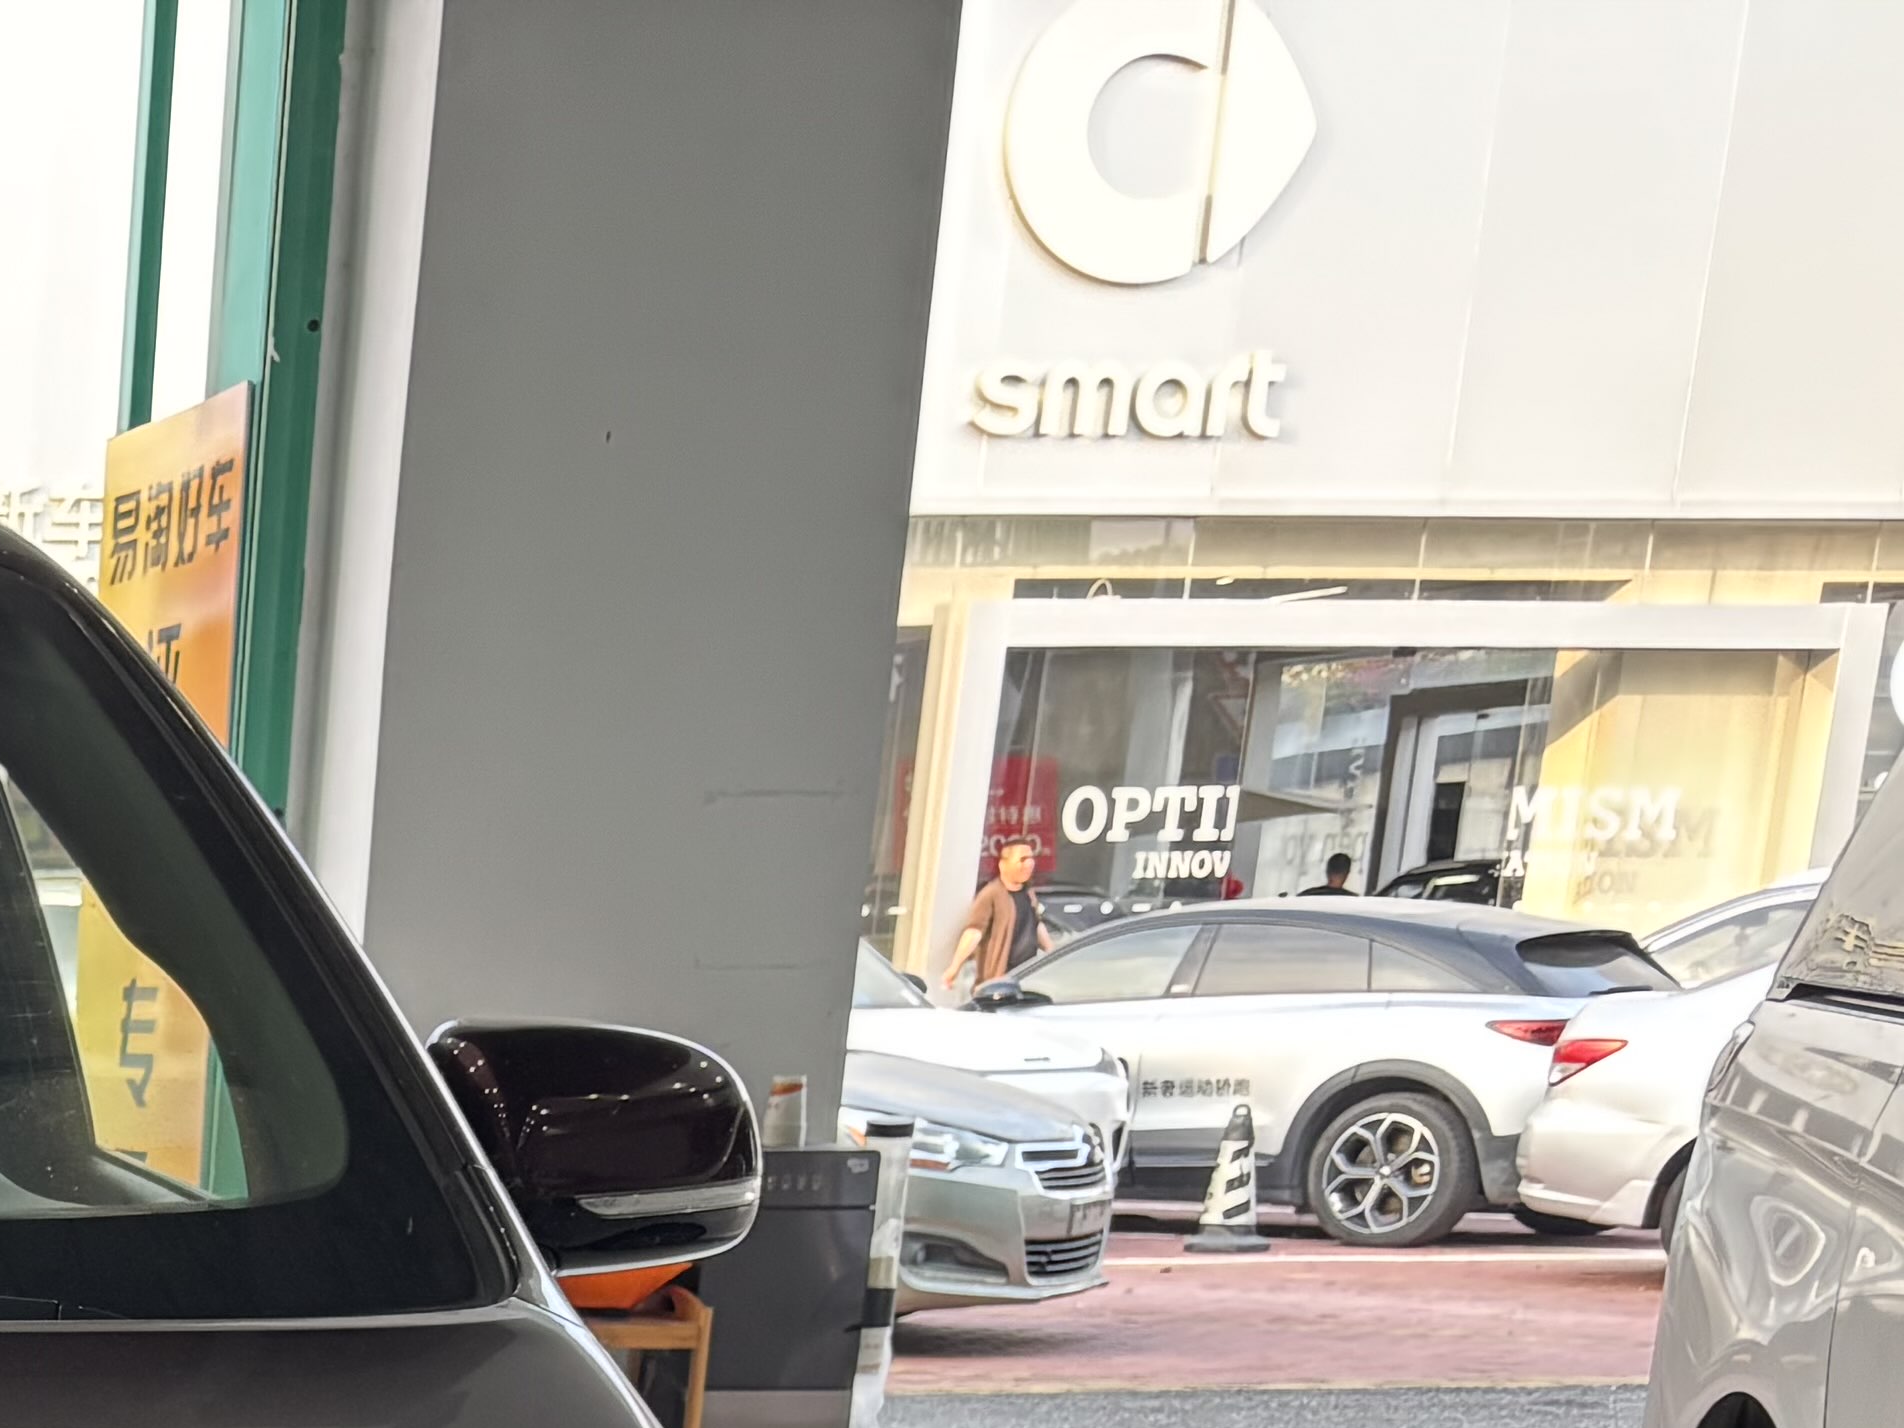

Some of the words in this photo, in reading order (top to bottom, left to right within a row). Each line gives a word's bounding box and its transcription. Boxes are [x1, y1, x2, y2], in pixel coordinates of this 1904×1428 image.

[969, 349, 1287, 438] smart
[109, 458, 235, 586] 易淘好车
